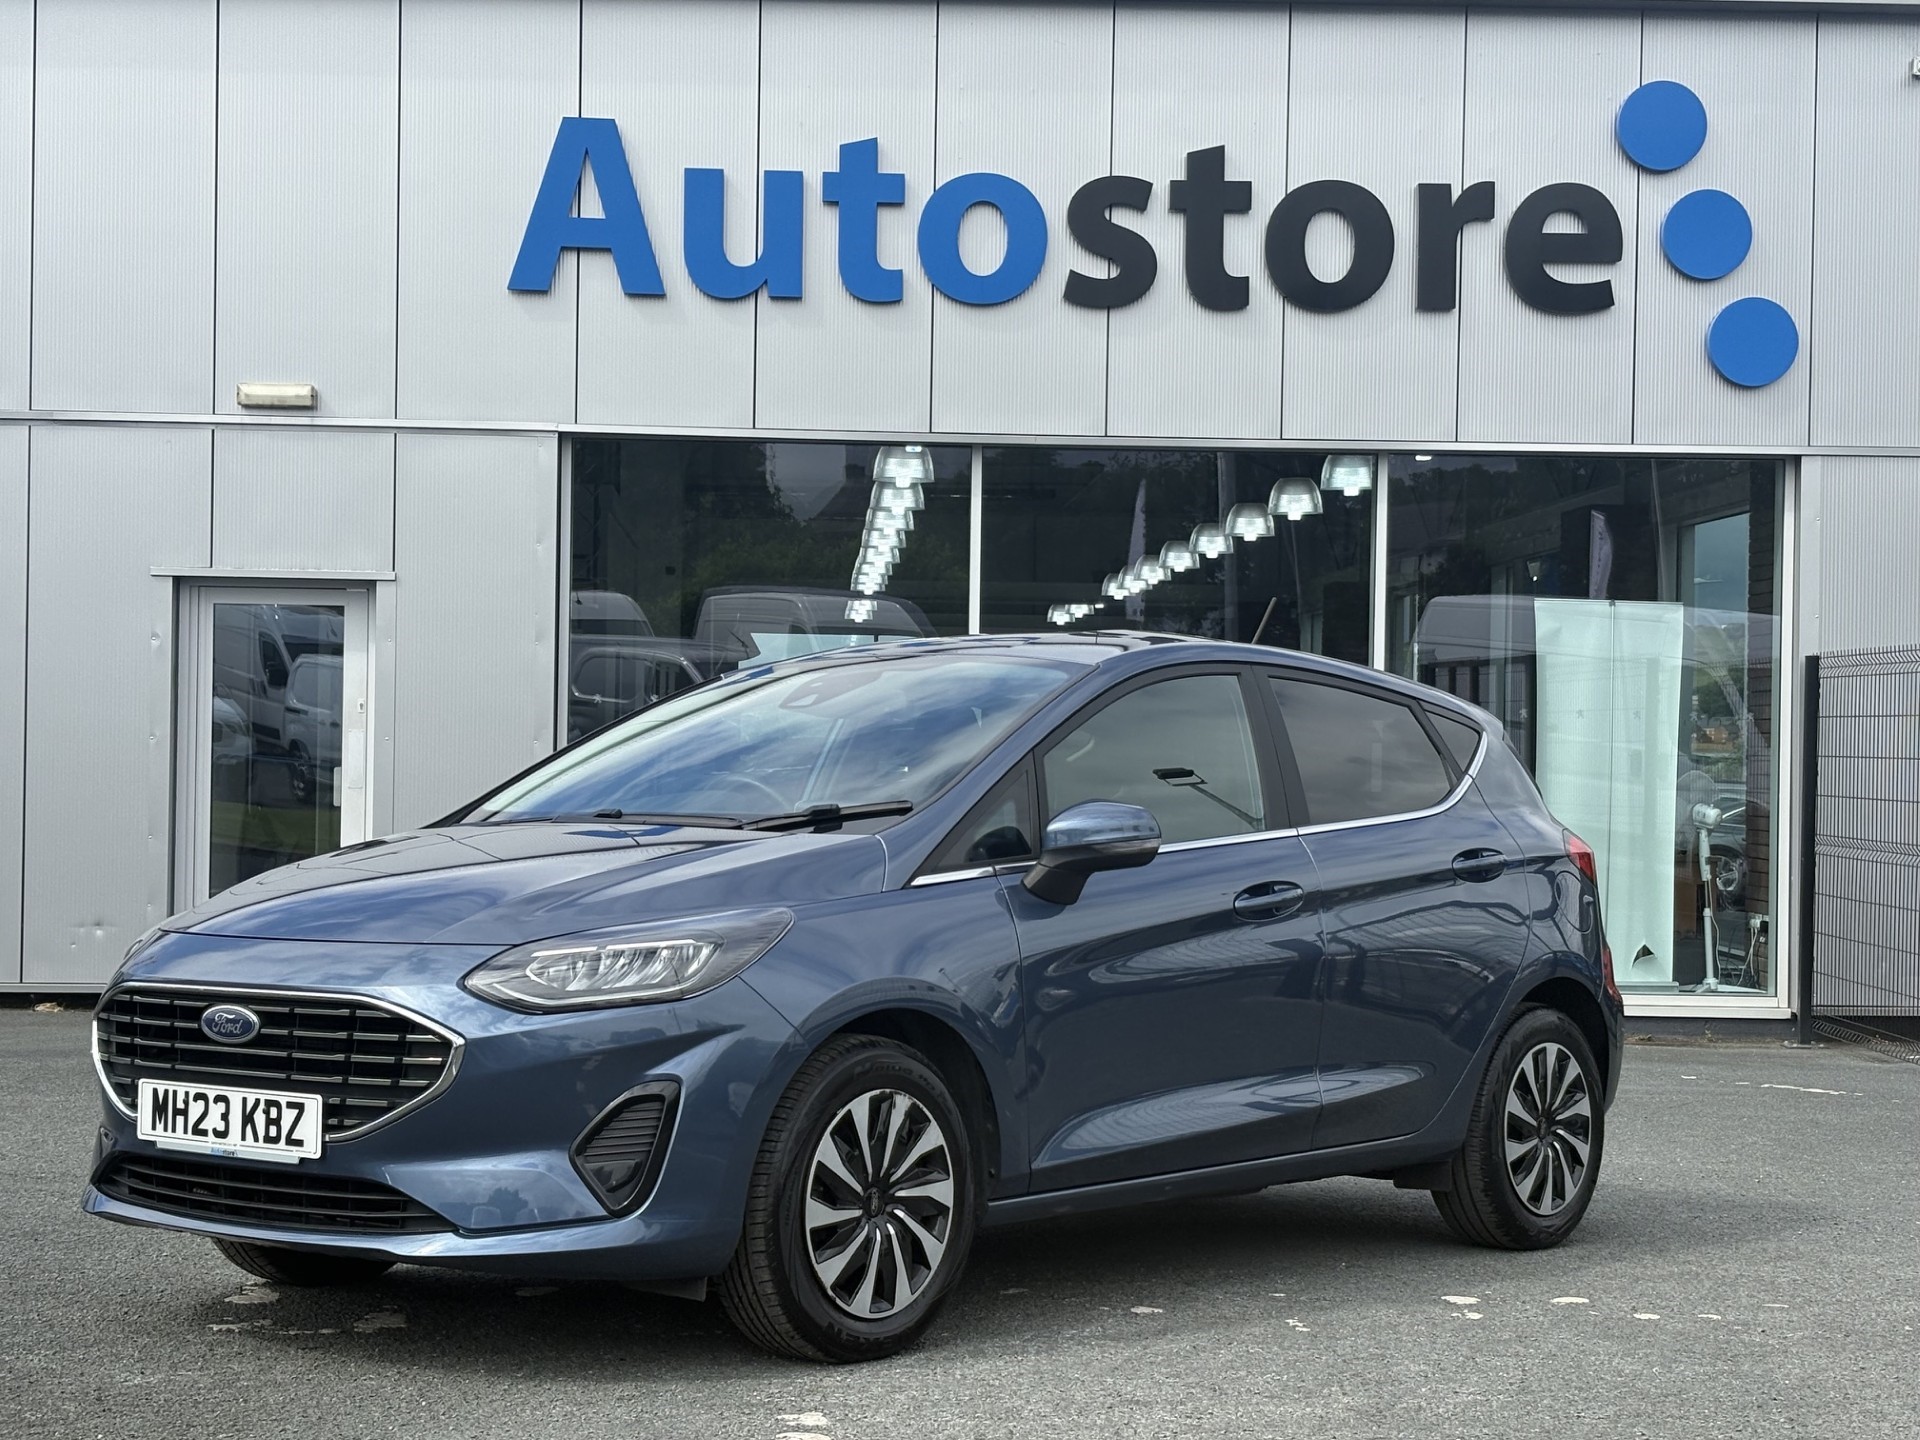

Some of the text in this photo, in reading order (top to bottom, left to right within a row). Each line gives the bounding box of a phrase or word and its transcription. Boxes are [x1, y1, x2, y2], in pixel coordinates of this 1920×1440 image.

[508, 116, 1622, 314] Autostore
[211, 1012, 243, 1034] Ford
[151, 1087, 306, 1148] MH23 KBZ
